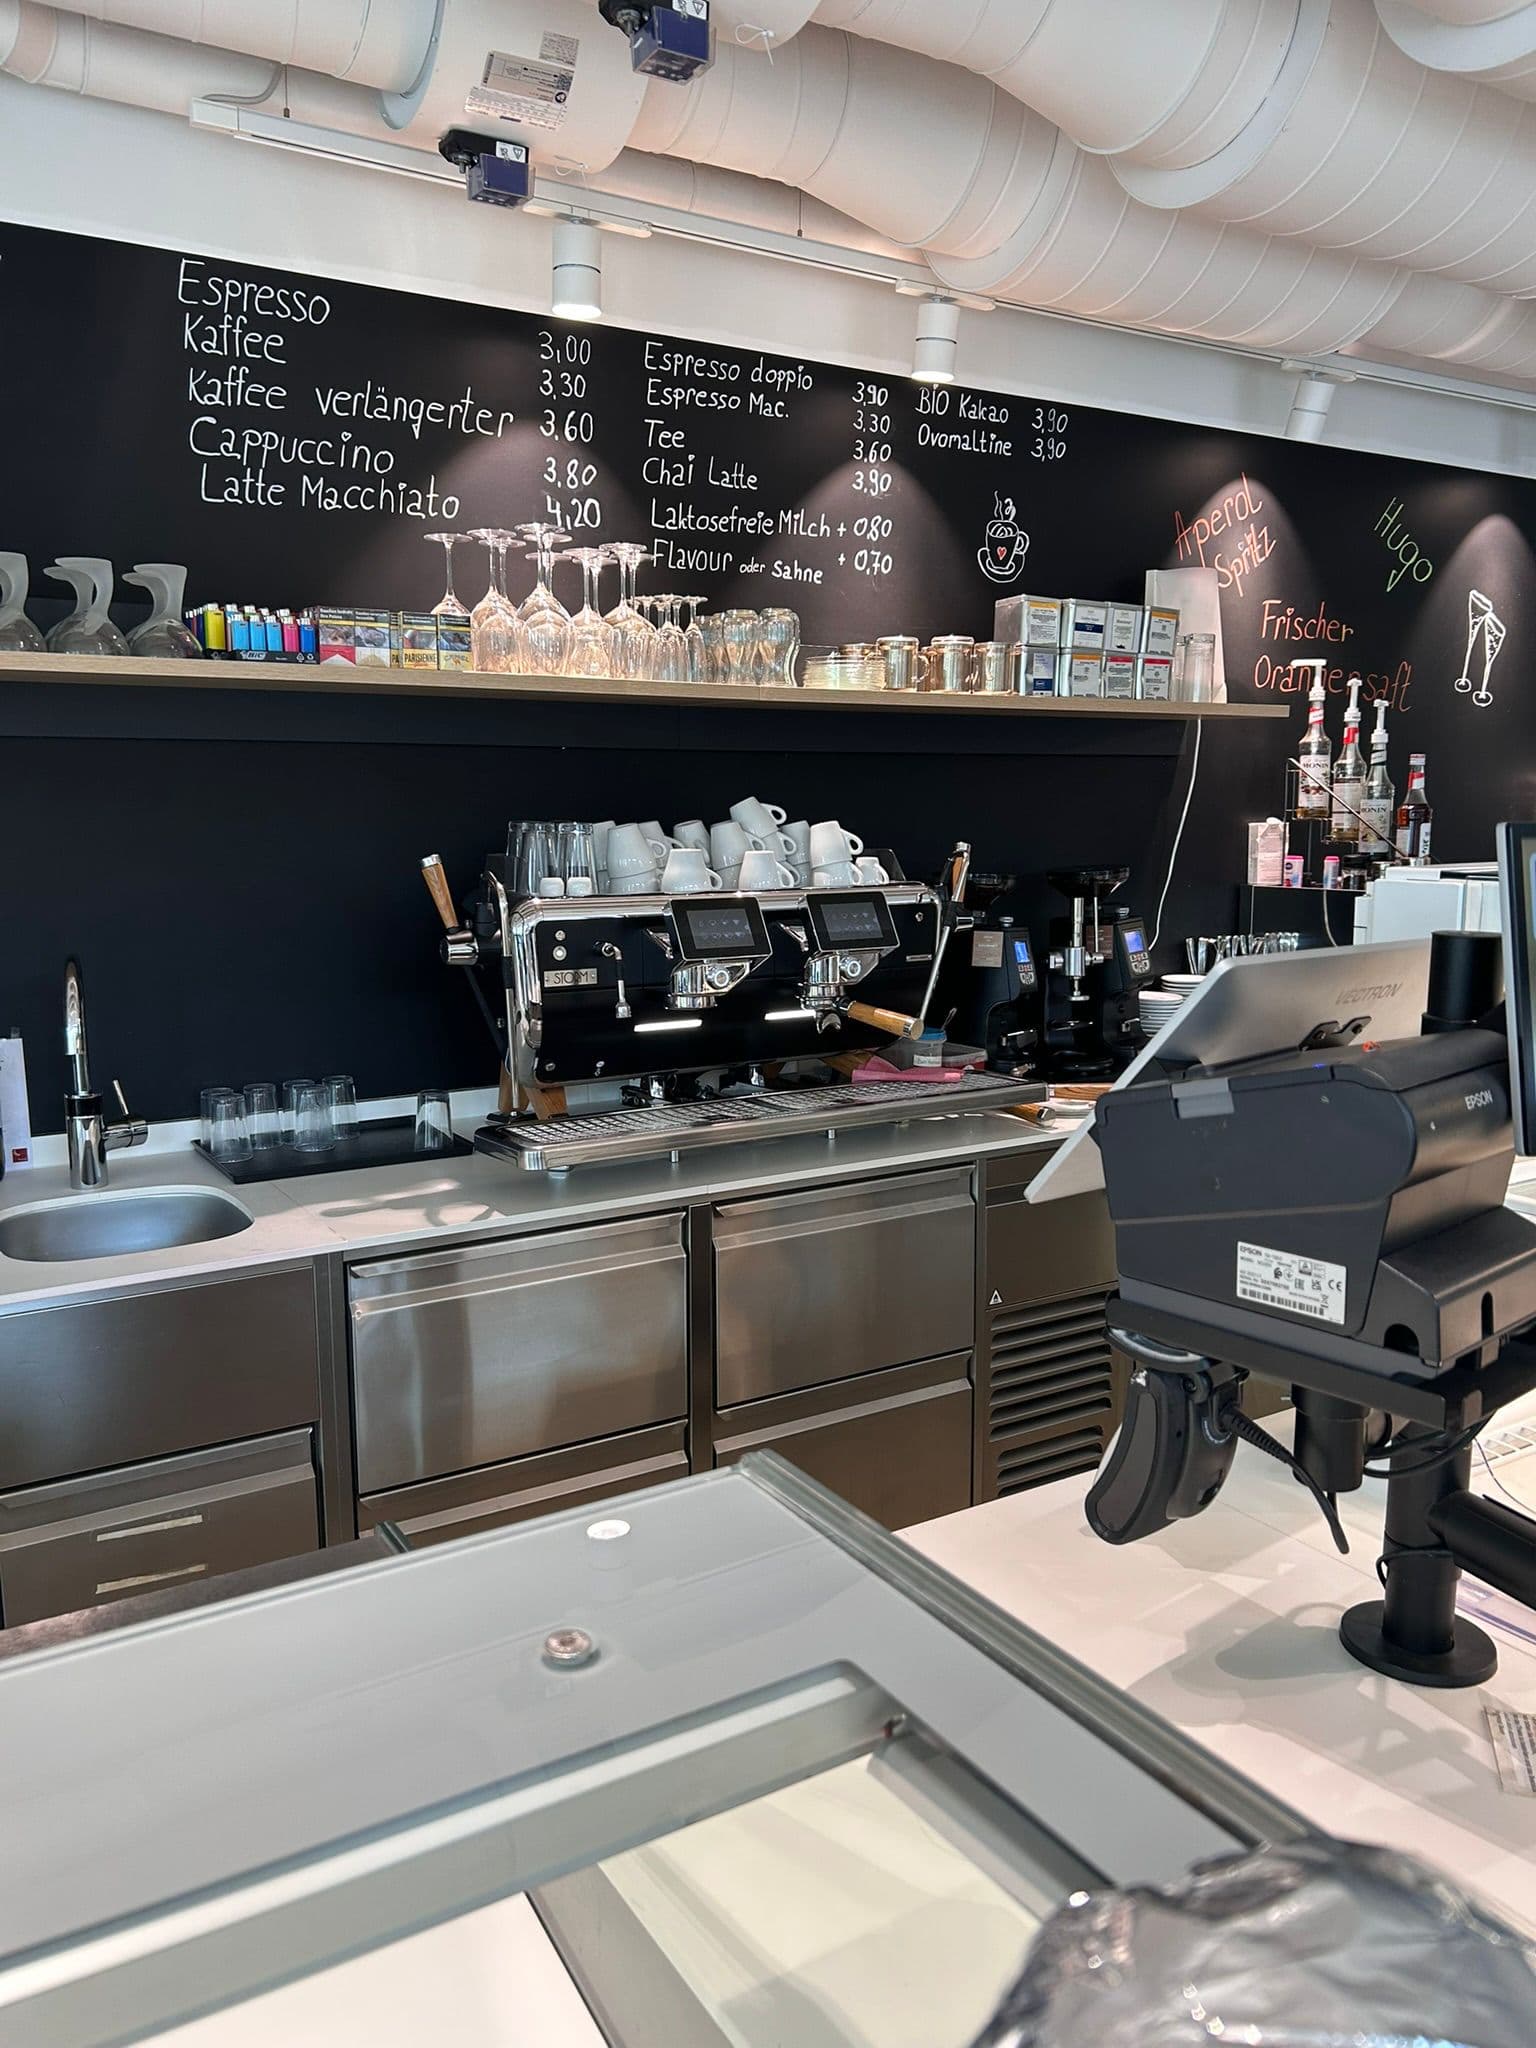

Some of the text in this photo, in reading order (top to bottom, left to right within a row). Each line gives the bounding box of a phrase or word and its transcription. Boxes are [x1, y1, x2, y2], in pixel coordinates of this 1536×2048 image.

[178, 257, 331, 325] Espresso
[184, 312, 287, 364] Kaffee
[643, 340, 741, 383] Espresso
[750, 355, 814, 394] doppio
[188, 365, 289, 411] Kaffee
[315, 381, 514, 439] verlängerter
[646, 377, 741, 411] Espresso
[748, 390, 791, 420] Mac.
[958, 392, 1010, 425] Kakao
[189, 415, 395, 476] Cappuccino
[643, 417, 687, 450] Tee
[917, 422, 1013, 458] Ovomaltine
[200, 463, 286, 507] Latte
[300, 474, 461, 521] Macchiato
[642, 453, 695, 487] Chai
[708, 455, 759, 492] Latte
[650, 497, 775, 537] Laktosefreie
[777, 507, 831, 538] Milch
[836, 522, 848, 538] +
[1173, 471, 1263, 569] Aperol
[652, 537, 734, 574] Flavour
[738, 556, 766, 575] oder
[770, 559, 824, 586] Sahne
[837, 552, 847, 567] +
[1214, 522, 1277, 598] Spritz
[1373, 496, 1434, 593] Hugo
[1260, 599, 1355, 643] Frischer
[553, 970, 588, 985] STORM
[1335, 983, 1402, 1005] VECTRON
[1465, 1090, 1493, 1110] EPSON
